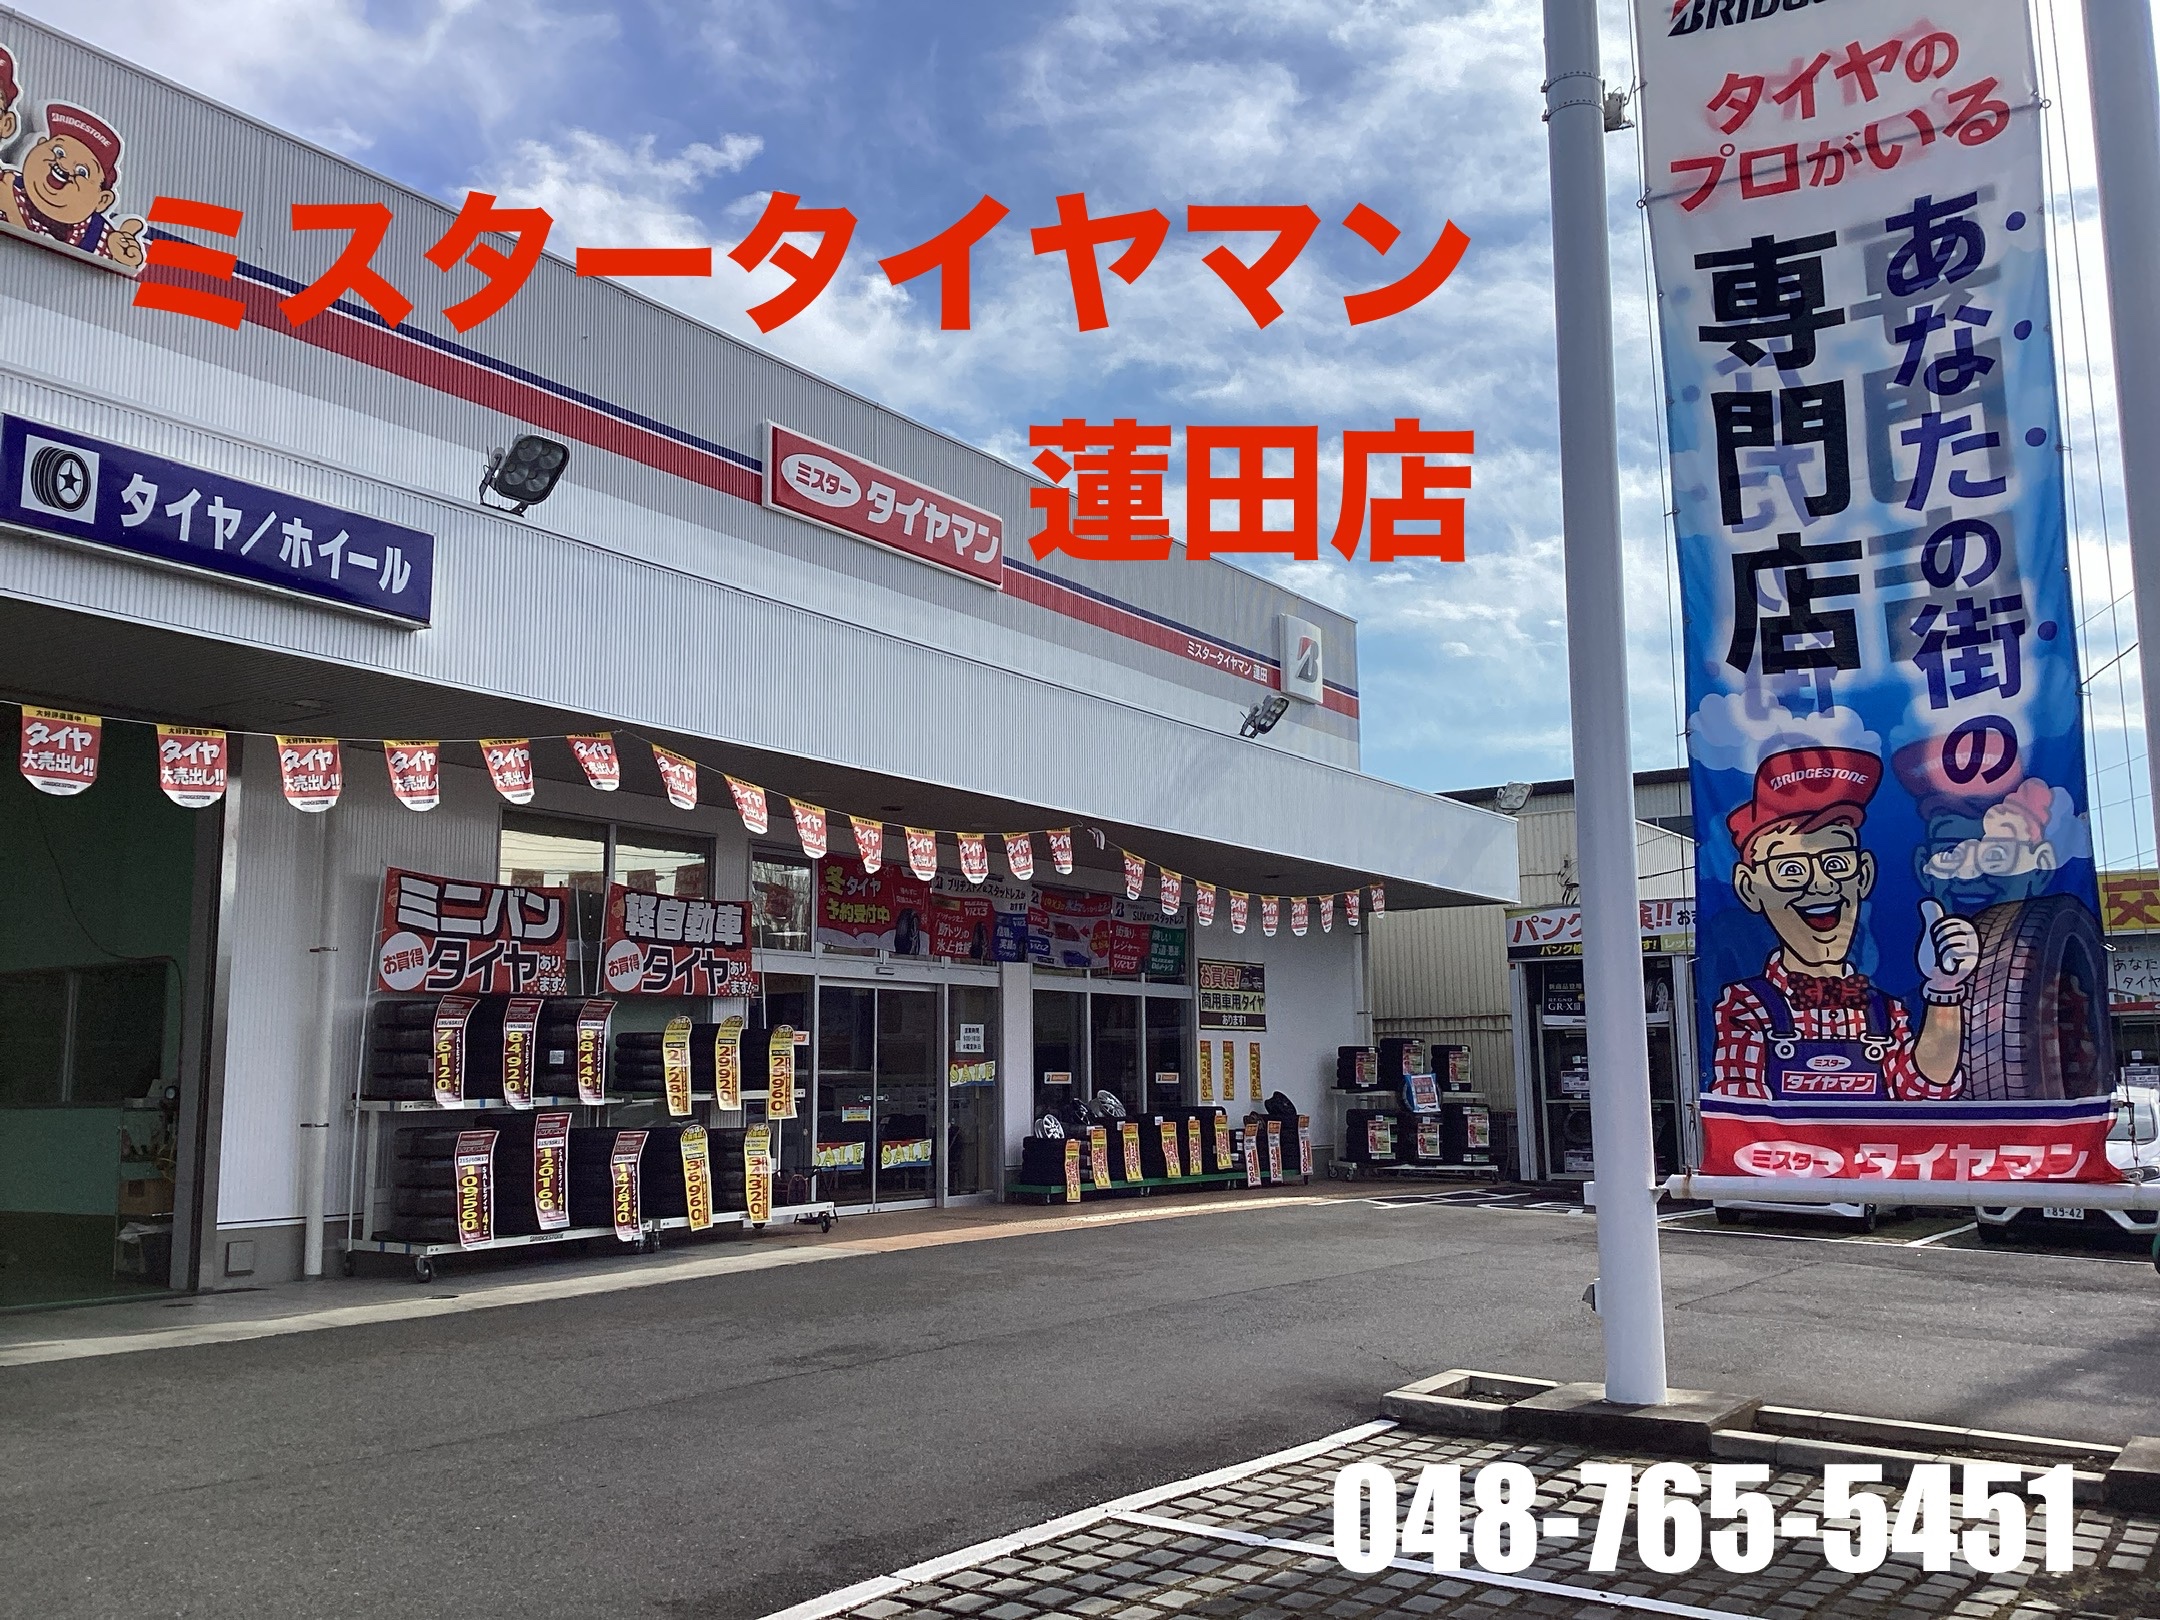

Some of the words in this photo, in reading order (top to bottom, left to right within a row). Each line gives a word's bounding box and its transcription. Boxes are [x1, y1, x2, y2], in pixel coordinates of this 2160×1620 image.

[1707, 31, 1960, 136] タイヤの
[51, 112, 112, 147] BRIDGESTONE
[1670, 76, 2011, 213] プロがいる
[1693, 230, 1863, 677] 専門店
[1885, 190, 2026, 785] あなたの街の
[796, 460, 852, 494] ミスター
[866, 480, 999, 564] タイヤマン
[1187, 640, 1252, 676] ミスタータイヤマン
[1252, 663, 1268, 684] 蓮田
[25, 721, 93, 752] タイヤ
[22, 749, 95, 777] 大売出し!!
[160, 739, 220, 766] タイヤ
[280, 748, 334, 773] タイヤ
[390, 749, 437, 773] タイヤ
[487, 748, 530, 771] タイヤ
[573, 740, 612, 761] タイヤ
[161, 765, 225, 787] 大売出し!!
[656, 756, 694, 782] タイヤ
[1770, 767, 1869, 792] BRIDGESTONE
[283, 774, 341, 792] 大売出し!!
[731, 784, 764, 809] タイヤ
[793, 808, 823, 832] タイヤ
[907, 833, 934, 854] タイヤ
[959, 840, 984, 859] タイヤ
[1006, 839, 1030, 857] タイヤ
[824, 865, 882, 897] 冬タイヤ
[397, 875, 561, 940] ミニバン
[826, 897, 891, 925] 予約受付中
[2101, 878, 2160, 926] 交
[624, 892, 743, 946] 軽自動車
[1512, 912, 1582, 944] パンク
[936, 938, 972, 955] 氷上性能
[382, 946, 425, 975] お買得
[425, 937, 540, 994] タイヤ
[539, 955, 561, 971] あり
[608, 953, 640, 978] お買得
[641, 944, 730, 996] タイヤ
[730, 961, 747, 977] あり
[1113, 960, 1137, 971] VRX3
[1200, 964, 1242, 990] お買得!
[1201, 992, 1265, 1012] 商用車用タイヤ
[1221, 1014, 1247, 1026] あります!
[950, 1063, 995, 1083] SALE
[1813, 1058, 1846, 1068] ミスター
[1785, 1073, 1874, 1092] タイヤマン
[816, 1144, 863, 1167] SALE
[882, 1141, 931, 1164] SALE
[1752, 1150, 1829, 1170] ミスター
[1855, 1143, 2089, 1182] タイヤマン
[2052, 1207, 2082, 1218] 89-42
